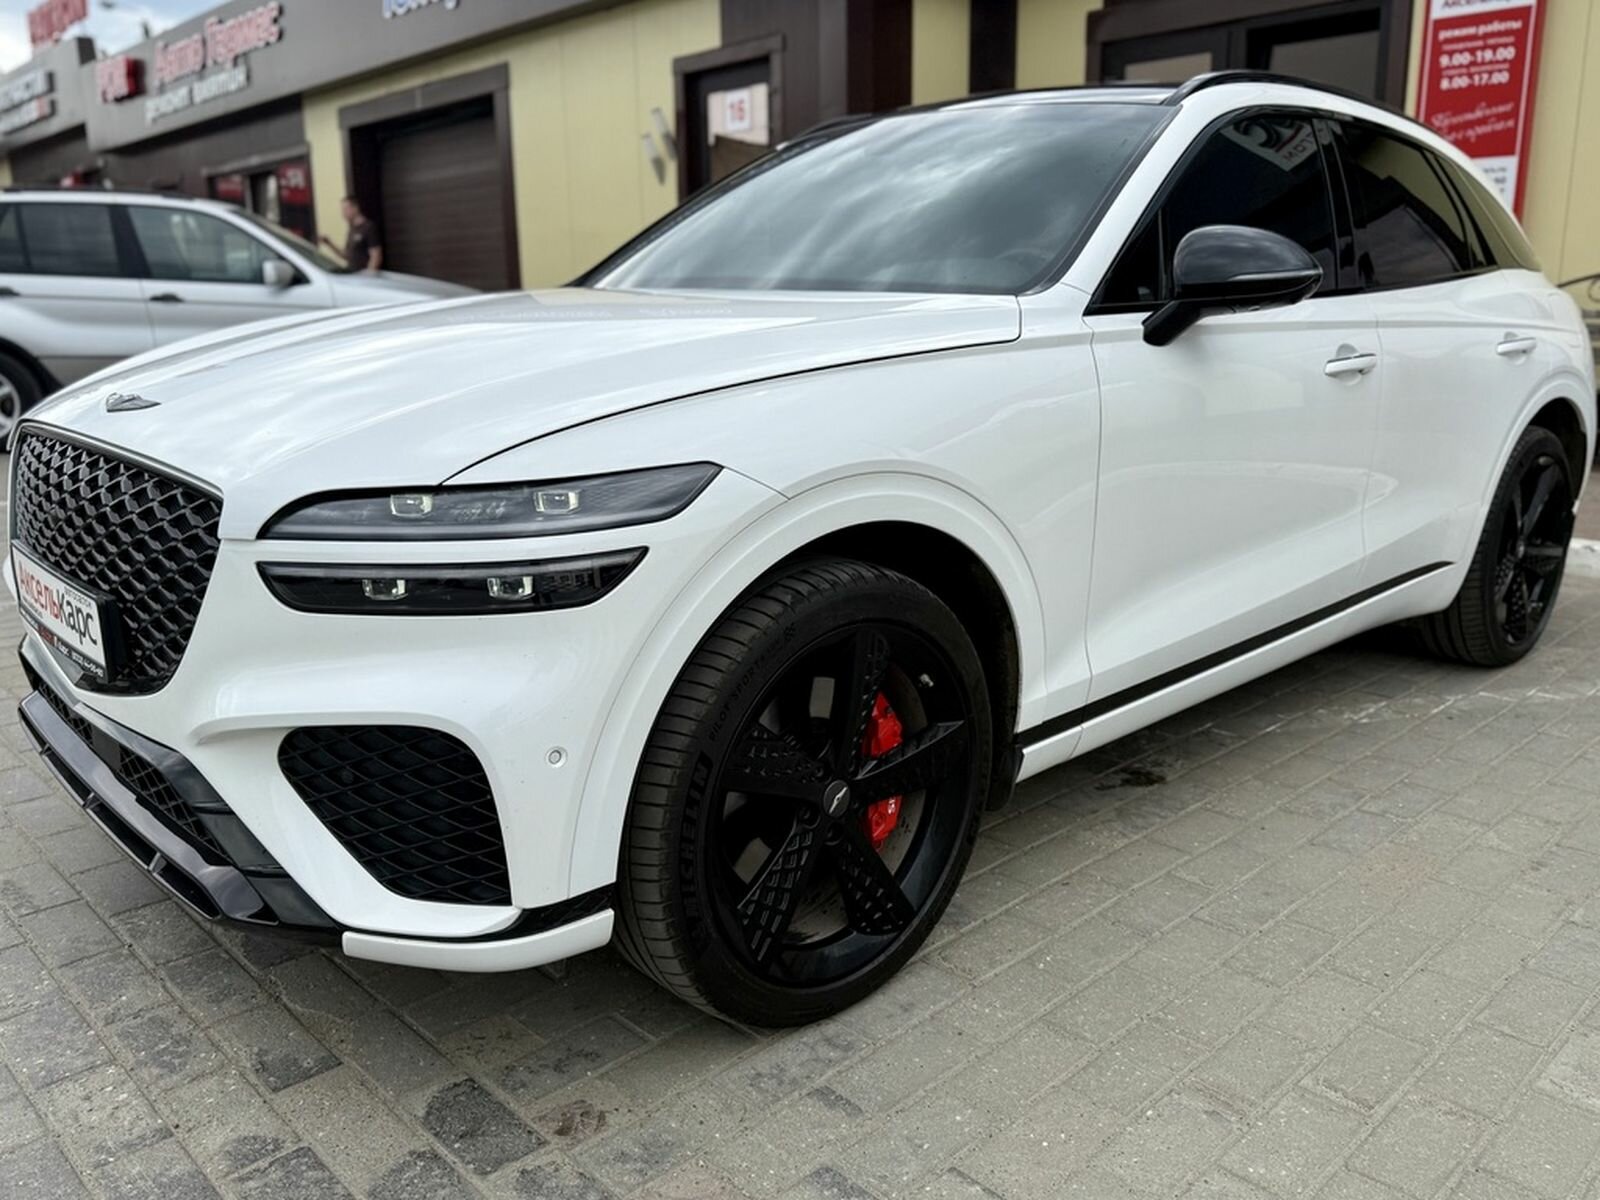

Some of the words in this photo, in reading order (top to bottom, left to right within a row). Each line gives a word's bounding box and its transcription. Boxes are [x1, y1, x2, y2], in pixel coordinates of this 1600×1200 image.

[1438, 26, 1477, 41] режим
[1478, 20, 1523, 36] работы
[1439, 46, 1516, 68] 9.00-19.00
[680, 761, 710, 918] MICHELIN
